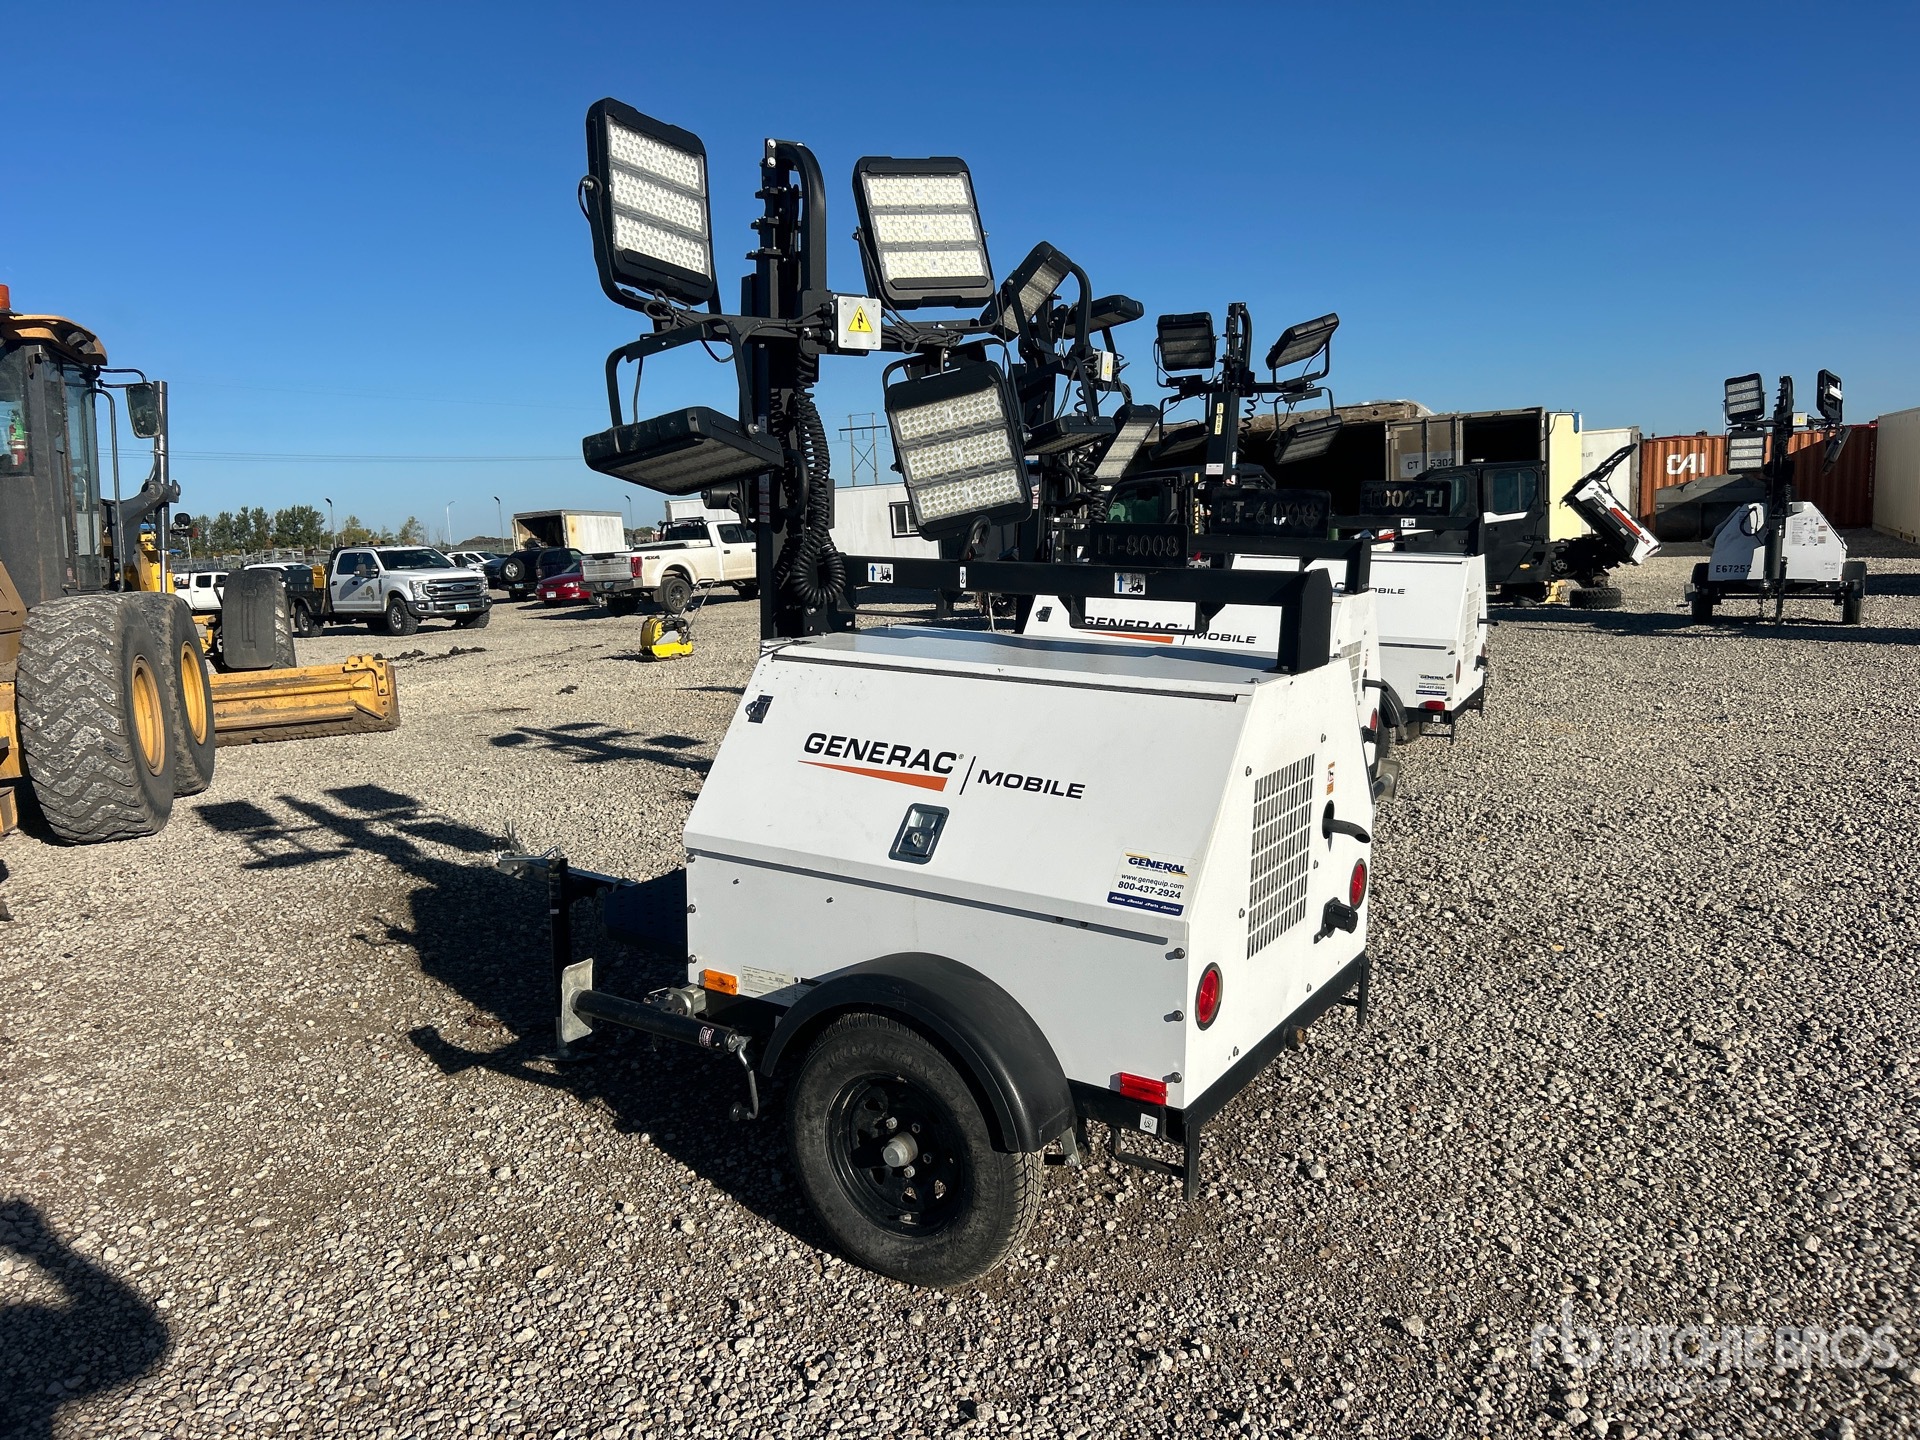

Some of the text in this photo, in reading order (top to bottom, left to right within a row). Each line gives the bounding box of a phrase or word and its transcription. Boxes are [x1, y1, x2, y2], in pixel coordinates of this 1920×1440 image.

[1407, 458, 1455, 470] CT 5302
[1666, 453, 1705, 475] CAI
[1715, 564, 1752, 573] E67252
[977, 769, 1086, 800] MOBILE
[1128, 857, 1186, 874] GENERAL
[1118, 880, 1181, 899] 800-437-2924
[1121, 873, 1185, 890] www.genequip.com
